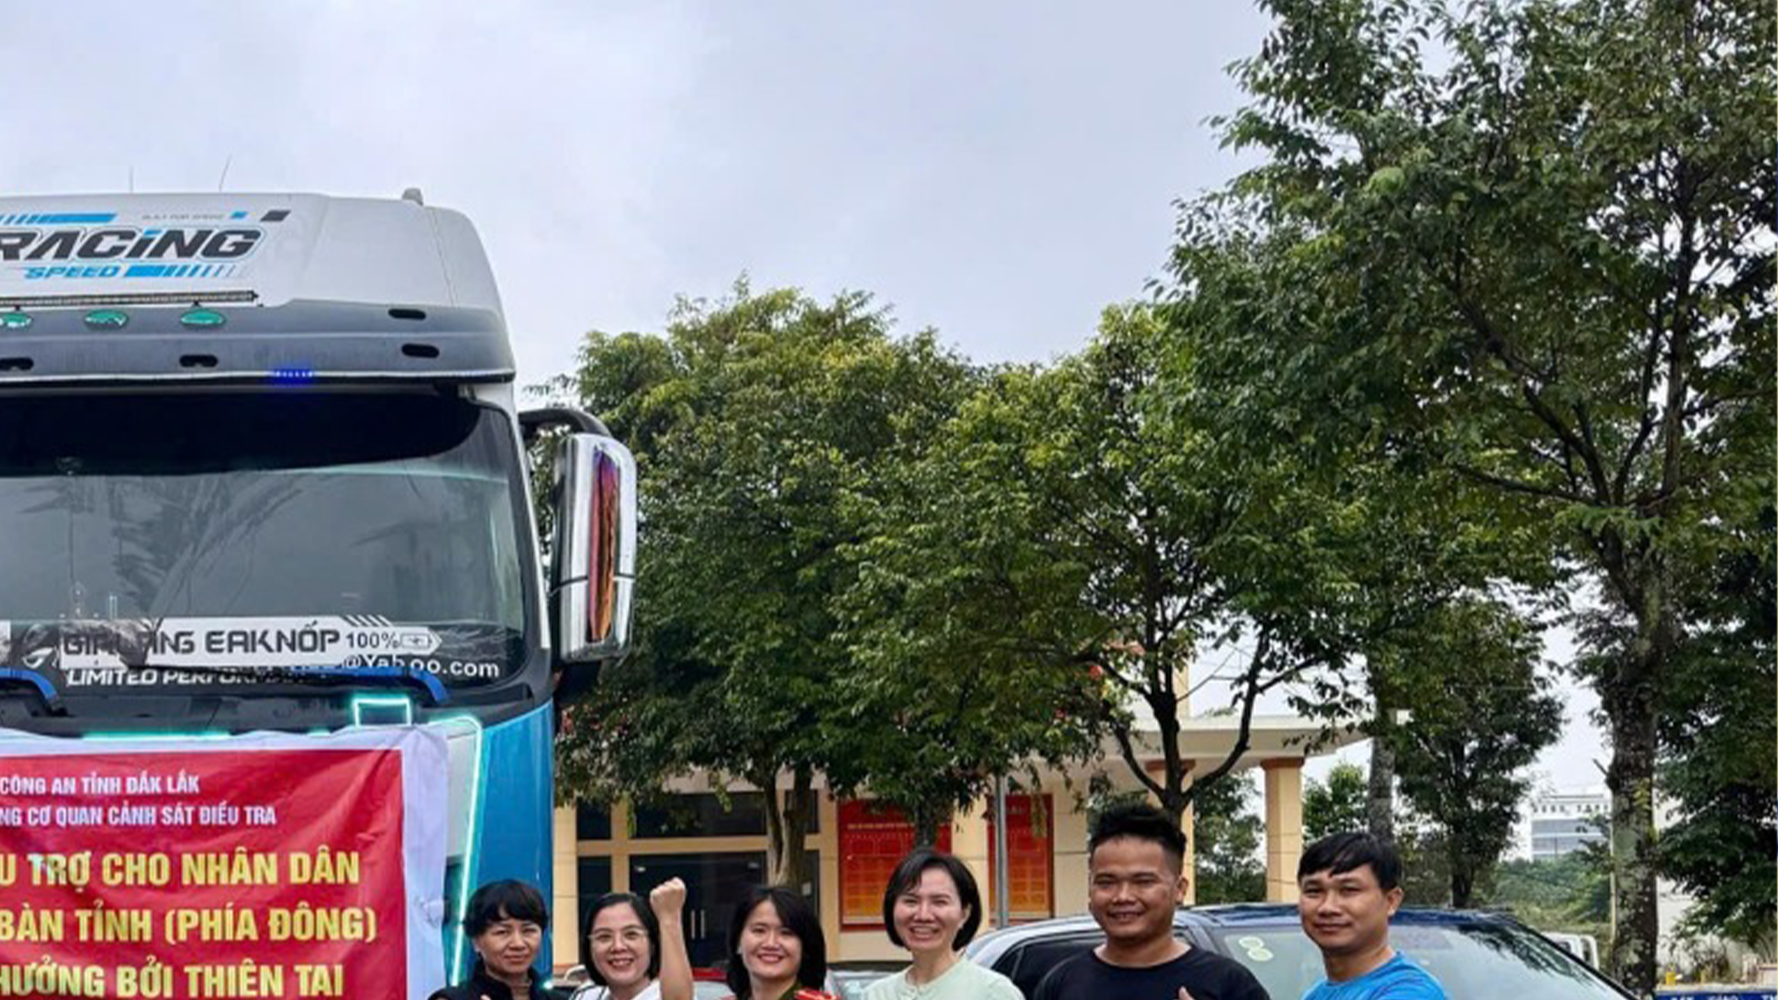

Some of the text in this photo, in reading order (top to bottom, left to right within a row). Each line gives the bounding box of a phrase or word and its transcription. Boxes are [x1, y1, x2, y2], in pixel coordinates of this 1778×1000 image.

[24, 265, 121, 279] SPEED
[205, 620, 341, 654] EAKNỐP
[346, 631, 399, 650] 100%
[67, 667, 158, 686] LIMITED
[51, 777, 76, 794] AN
[82, 771, 122, 794] TỈNH
[27, 805, 51, 826] CƠ
[56, 806, 103, 827] QUAN
[108, 803, 156, 825] CẢNH
[162, 803, 194, 824] SÁT
[200, 801, 239, 824] ĐIỀU
[244, 806, 277, 824] TRA
[27, 850, 92, 893] TRỢ
[102, 853, 170, 885] CHO
[181, 847, 278, 885] NHÂN
[289, 847, 360, 884] DÂN
[75, 901, 152, 941] TỈNH
[165, 902, 258, 945] (PHÍA
[268, 902, 378, 943] ĐÔNG)
[116, 954, 173, 998] BỞI
[184, 957, 284, 997] THIÊN
[294, 964, 344, 997] TAI
